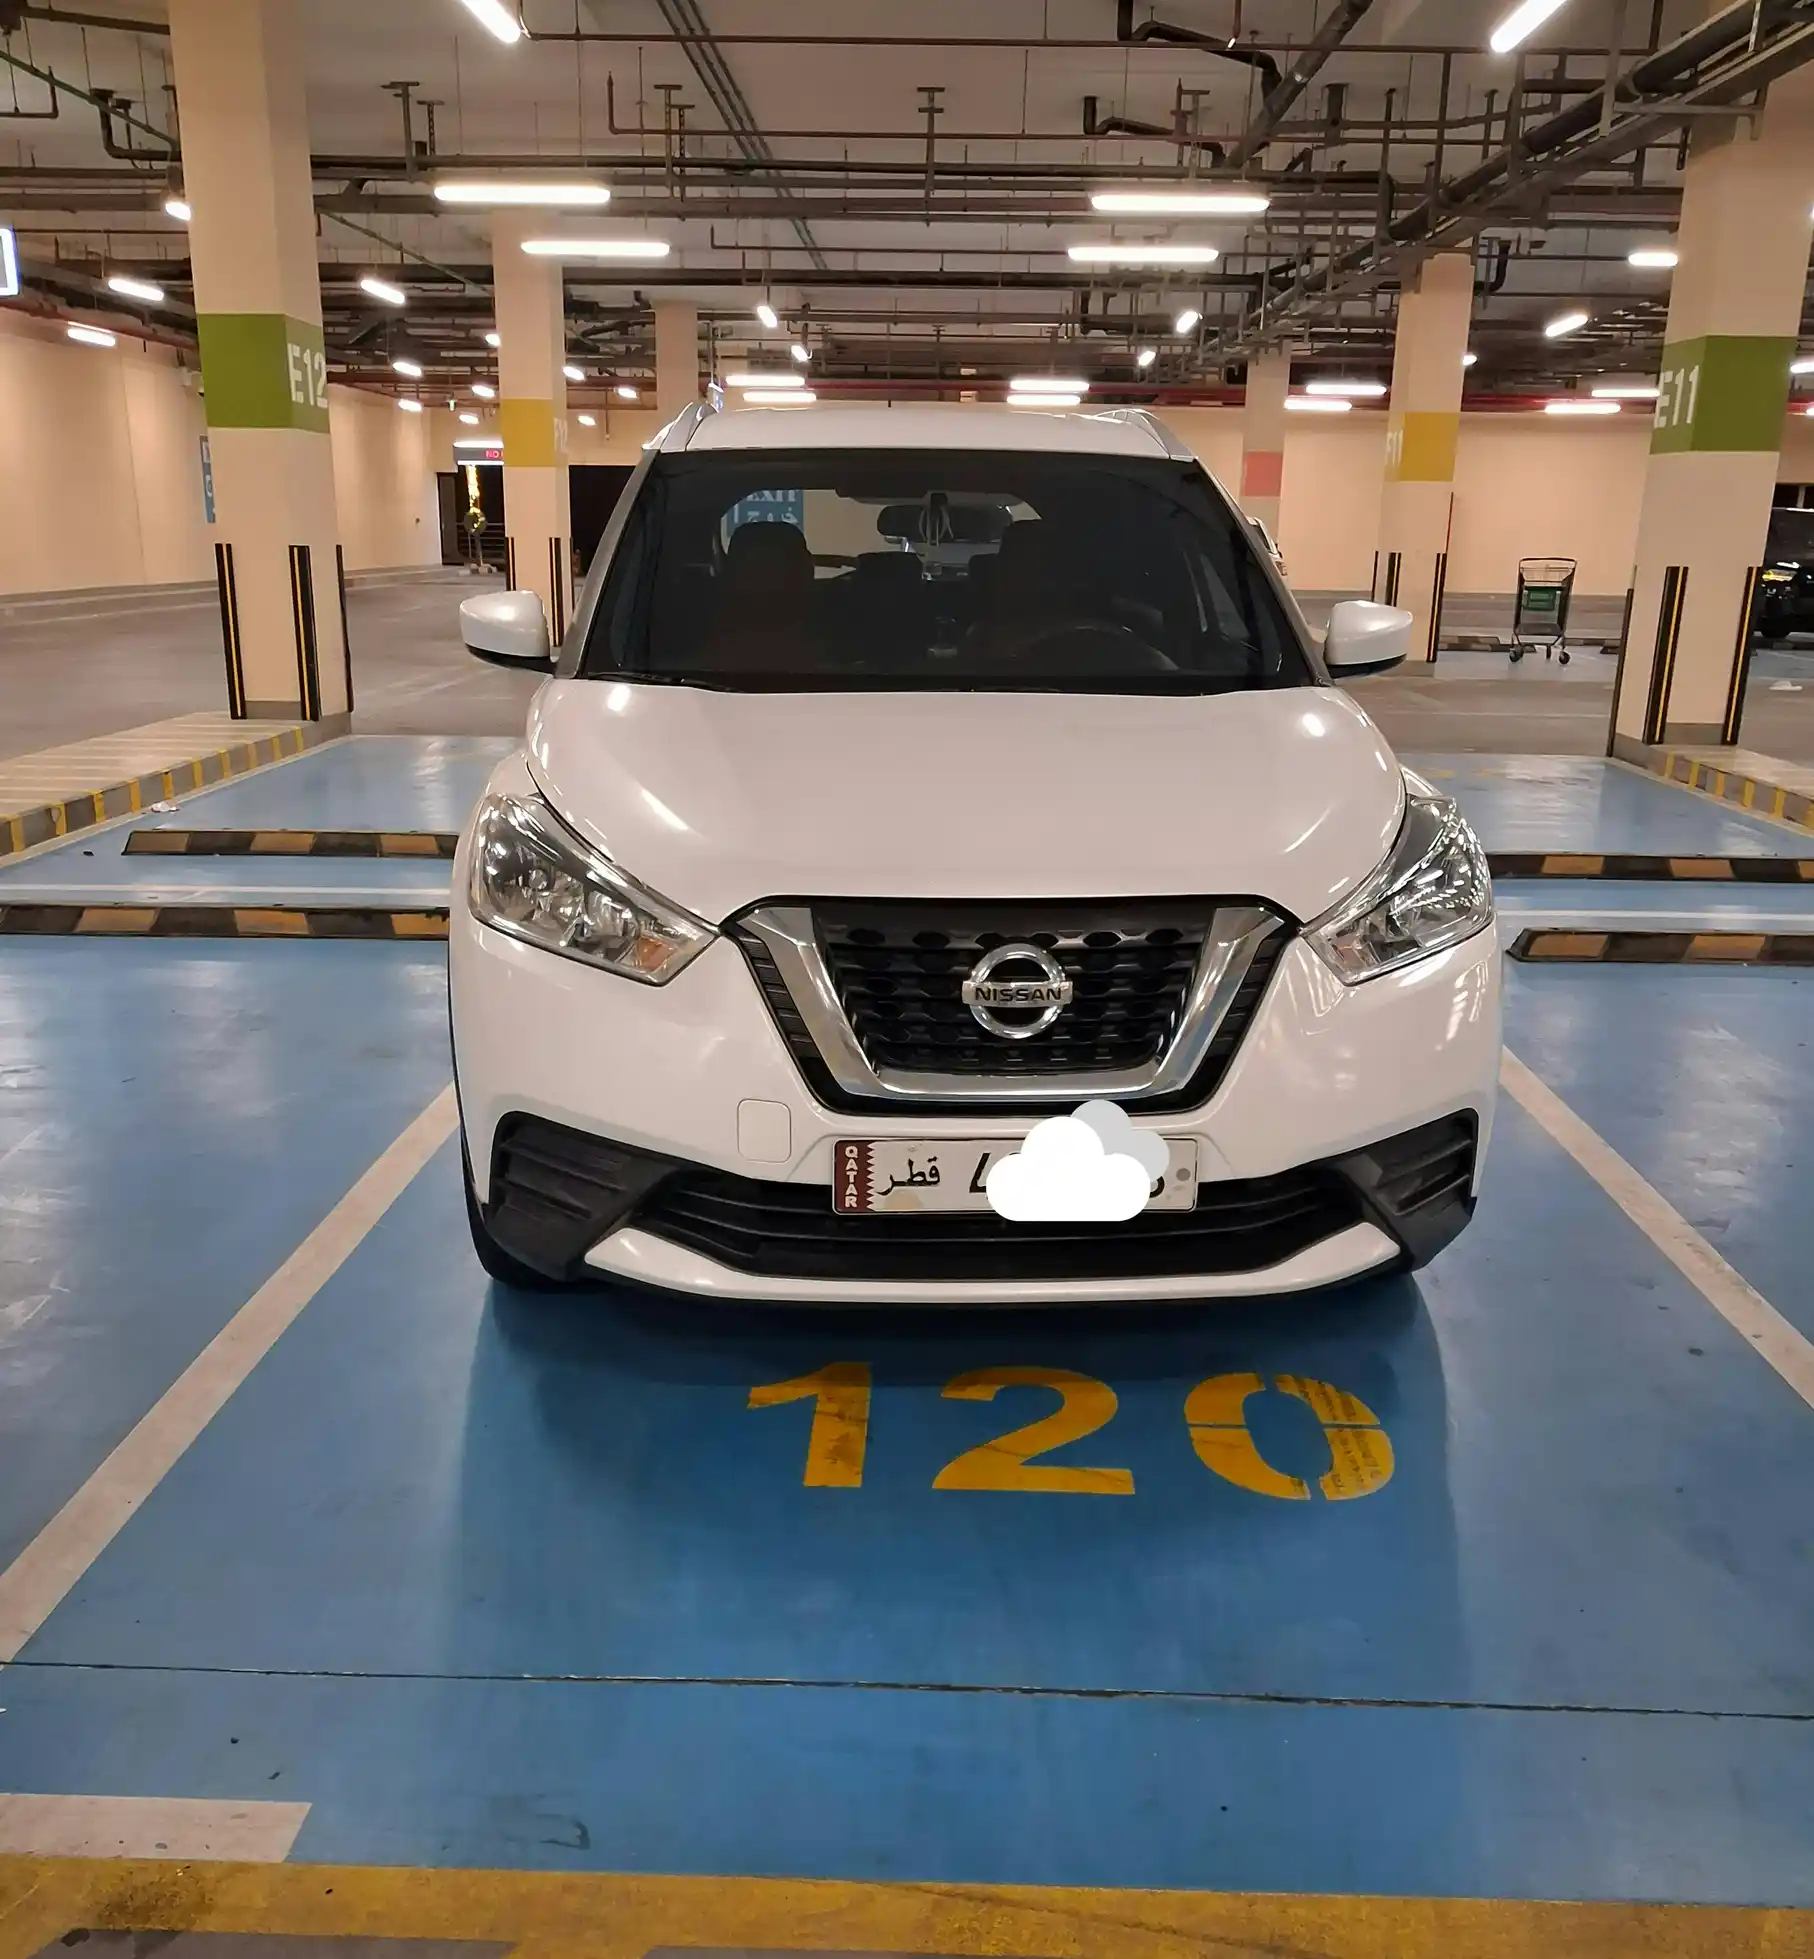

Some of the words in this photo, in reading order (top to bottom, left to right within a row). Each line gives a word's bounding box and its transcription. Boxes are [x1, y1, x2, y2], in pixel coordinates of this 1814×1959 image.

[287, 343, 328, 408] E12
[1654, 365, 1699, 428] E11
[485, 450, 500, 459] NO
[975, 987, 1062, 1002] NISSAN
[844, 1146, 859, 1208] QATAR
[876, 1156, 941, 1196] قطر
[747, 1362, 1394, 1500] 120
